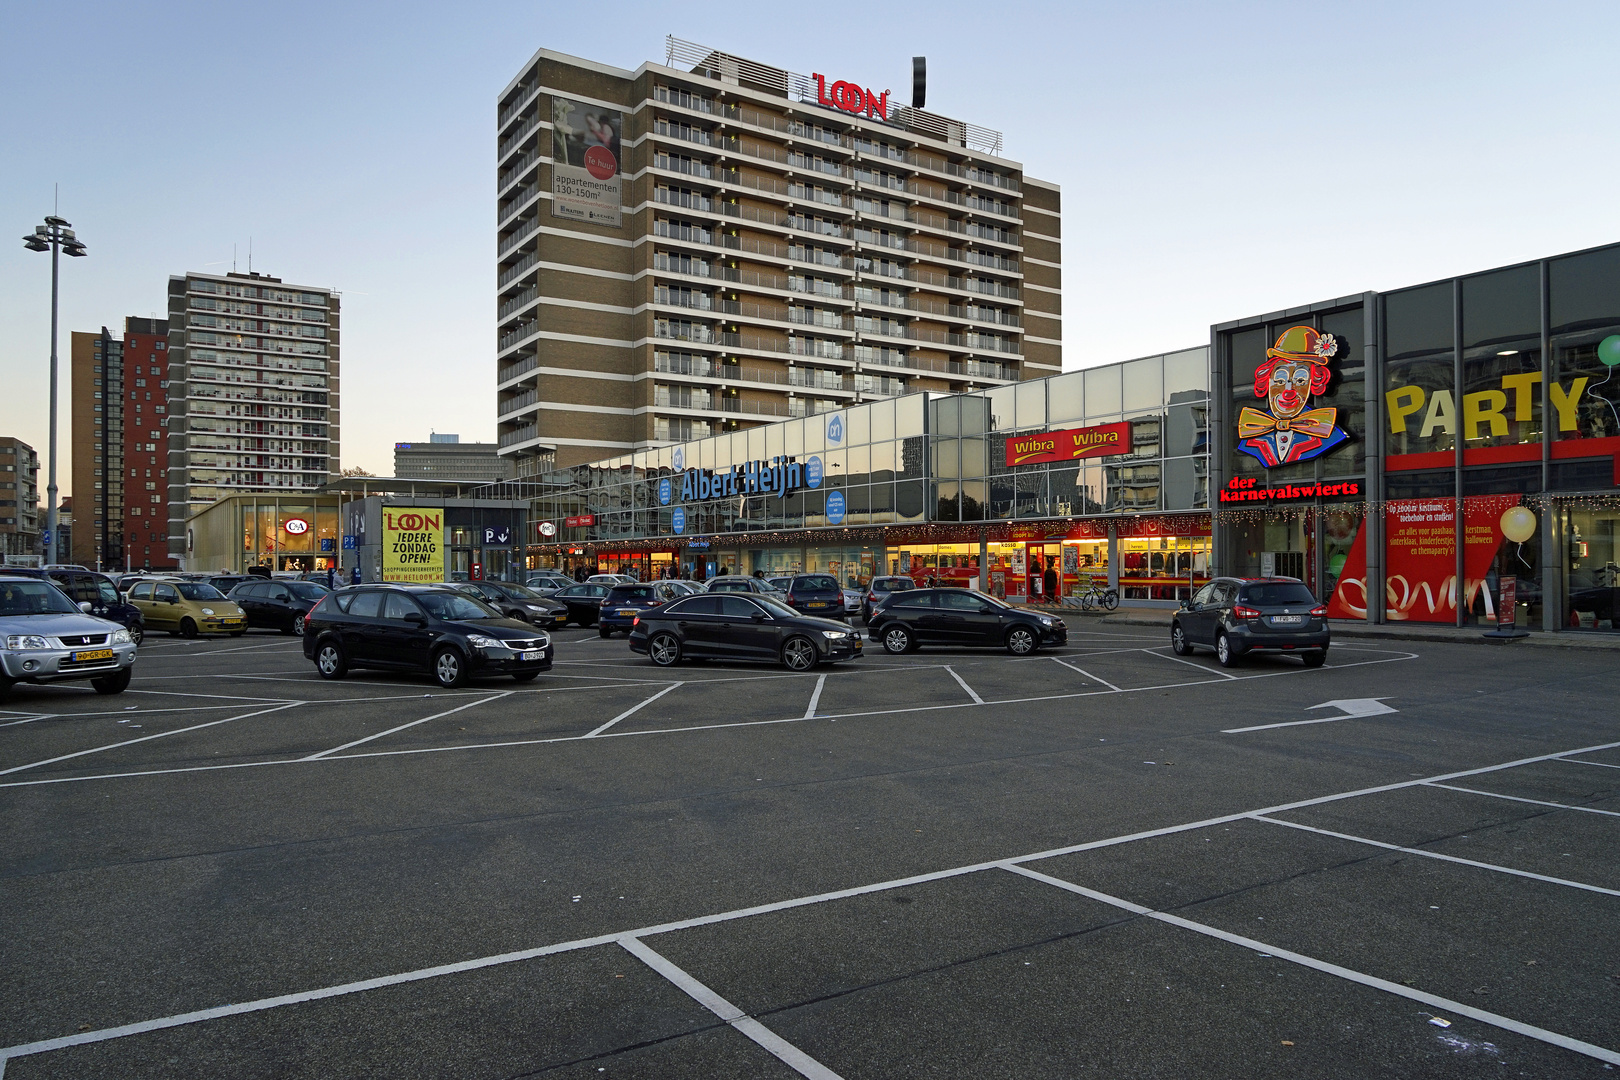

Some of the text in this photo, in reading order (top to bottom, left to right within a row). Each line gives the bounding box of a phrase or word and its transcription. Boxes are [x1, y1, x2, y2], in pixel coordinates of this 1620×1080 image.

[588, 156, 614, 170] Te huur
[556, 175, 618, 193] appartementen
[1385, 371, 1589, 439] PARTY
[1073, 429, 1119, 446] Wibra
[1014, 437, 1055, 454] Wibra
[681, 464, 738, 501] Albert
[745, 455, 801, 499] Heijn
[1229, 476, 1257, 490] der
[1220, 482, 1359, 502] karnevalswierts
[288, 522, 305, 531] C&A
[1406, 527, 1418, 535] alles
[397, 533, 433, 543] IEDERE
[1465, 535, 1493, 544] halloween
[392, 543, 436, 553] ZONDAG
[399, 553, 431, 564] OPEN!
[77, 651, 111, 660] 90-GR-GK
